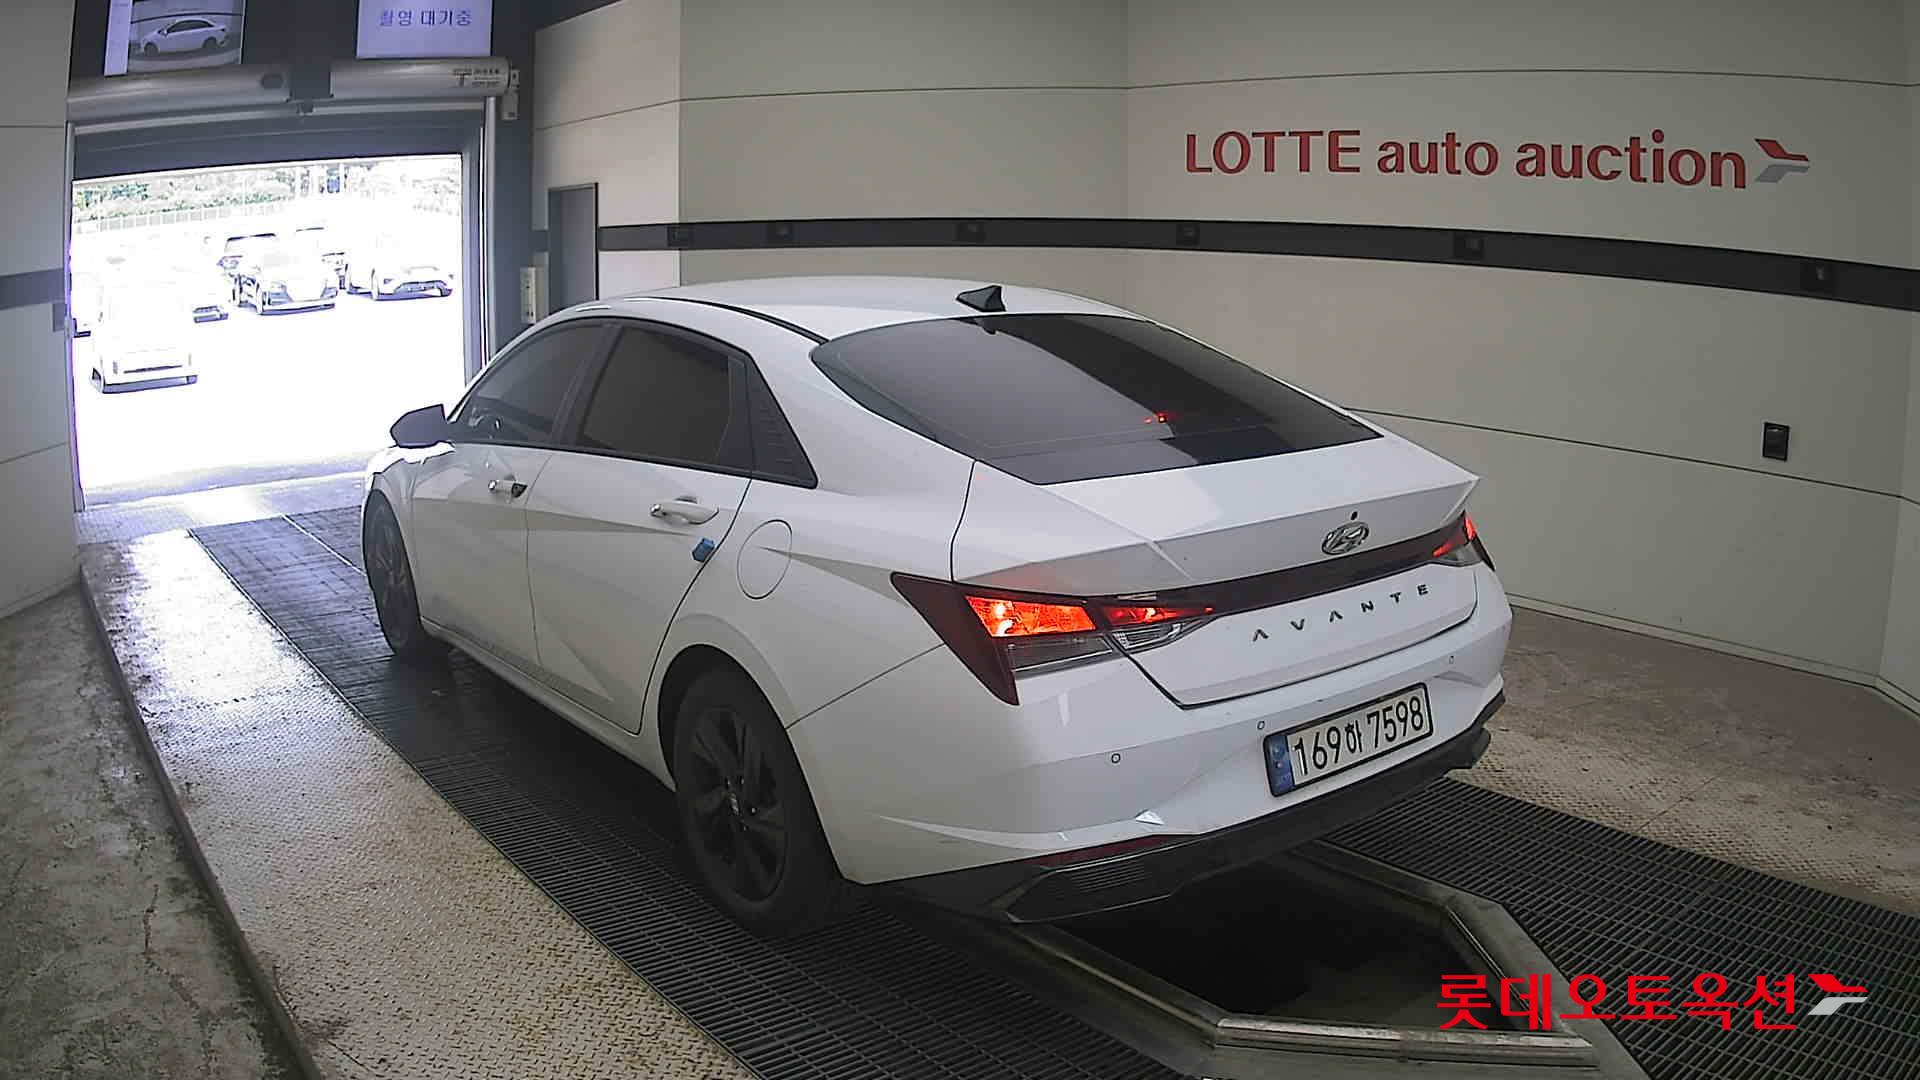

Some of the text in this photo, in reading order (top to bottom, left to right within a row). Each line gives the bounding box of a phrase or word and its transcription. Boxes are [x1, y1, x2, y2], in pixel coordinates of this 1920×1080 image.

[420, 9, 472, 27] 대기중
[1185, 129, 1747, 189] LOTTE auto auction
[1252, 583, 1429, 642] AVANTE
